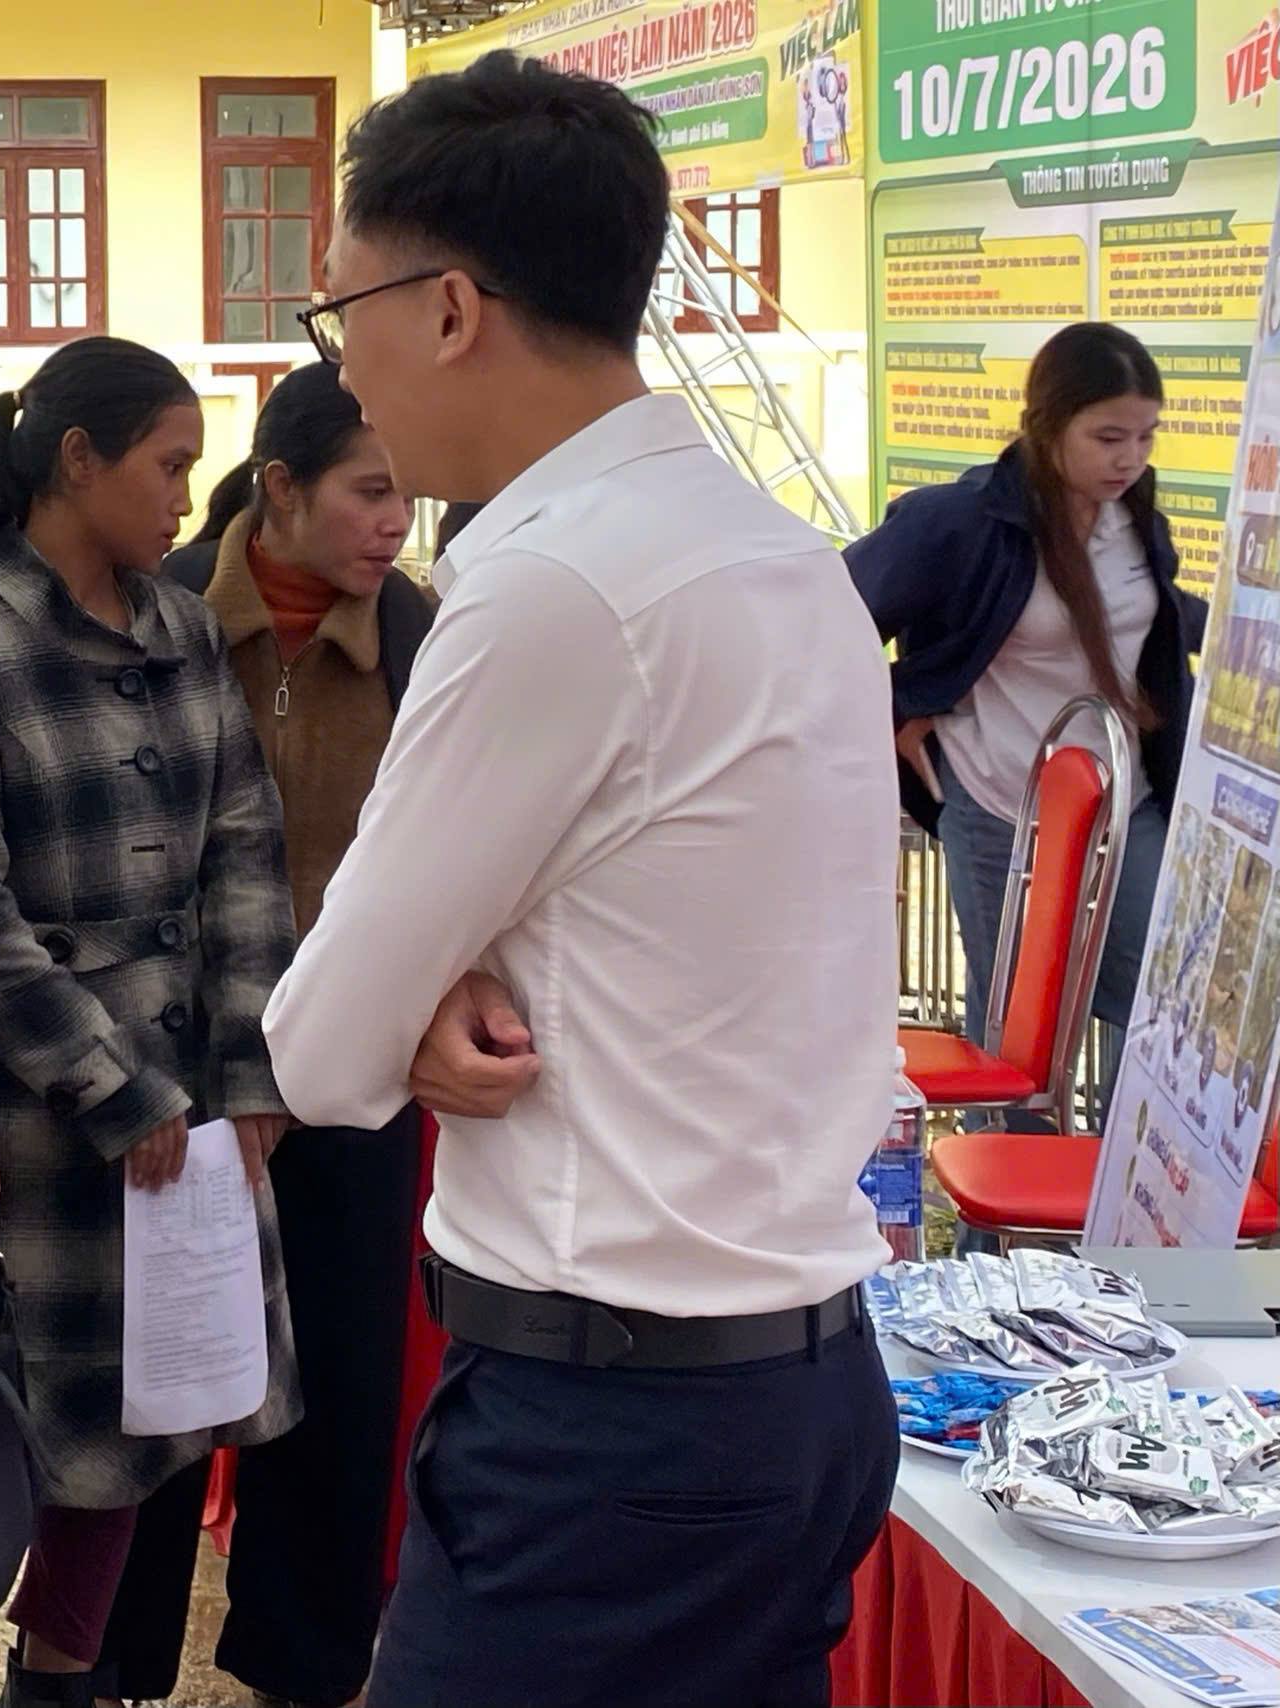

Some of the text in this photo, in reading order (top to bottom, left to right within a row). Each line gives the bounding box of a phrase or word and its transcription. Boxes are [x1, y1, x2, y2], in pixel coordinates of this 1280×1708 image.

[631, 14, 664, 73] LÀM
[667, 4, 707, 62] NĂM
[711, 0, 756, 51] 2026
[893, 26, 1166, 141] 10/7/2026
[1022, 151, 1170, 196] THÔNG TIN TUYỂN DỤNG
